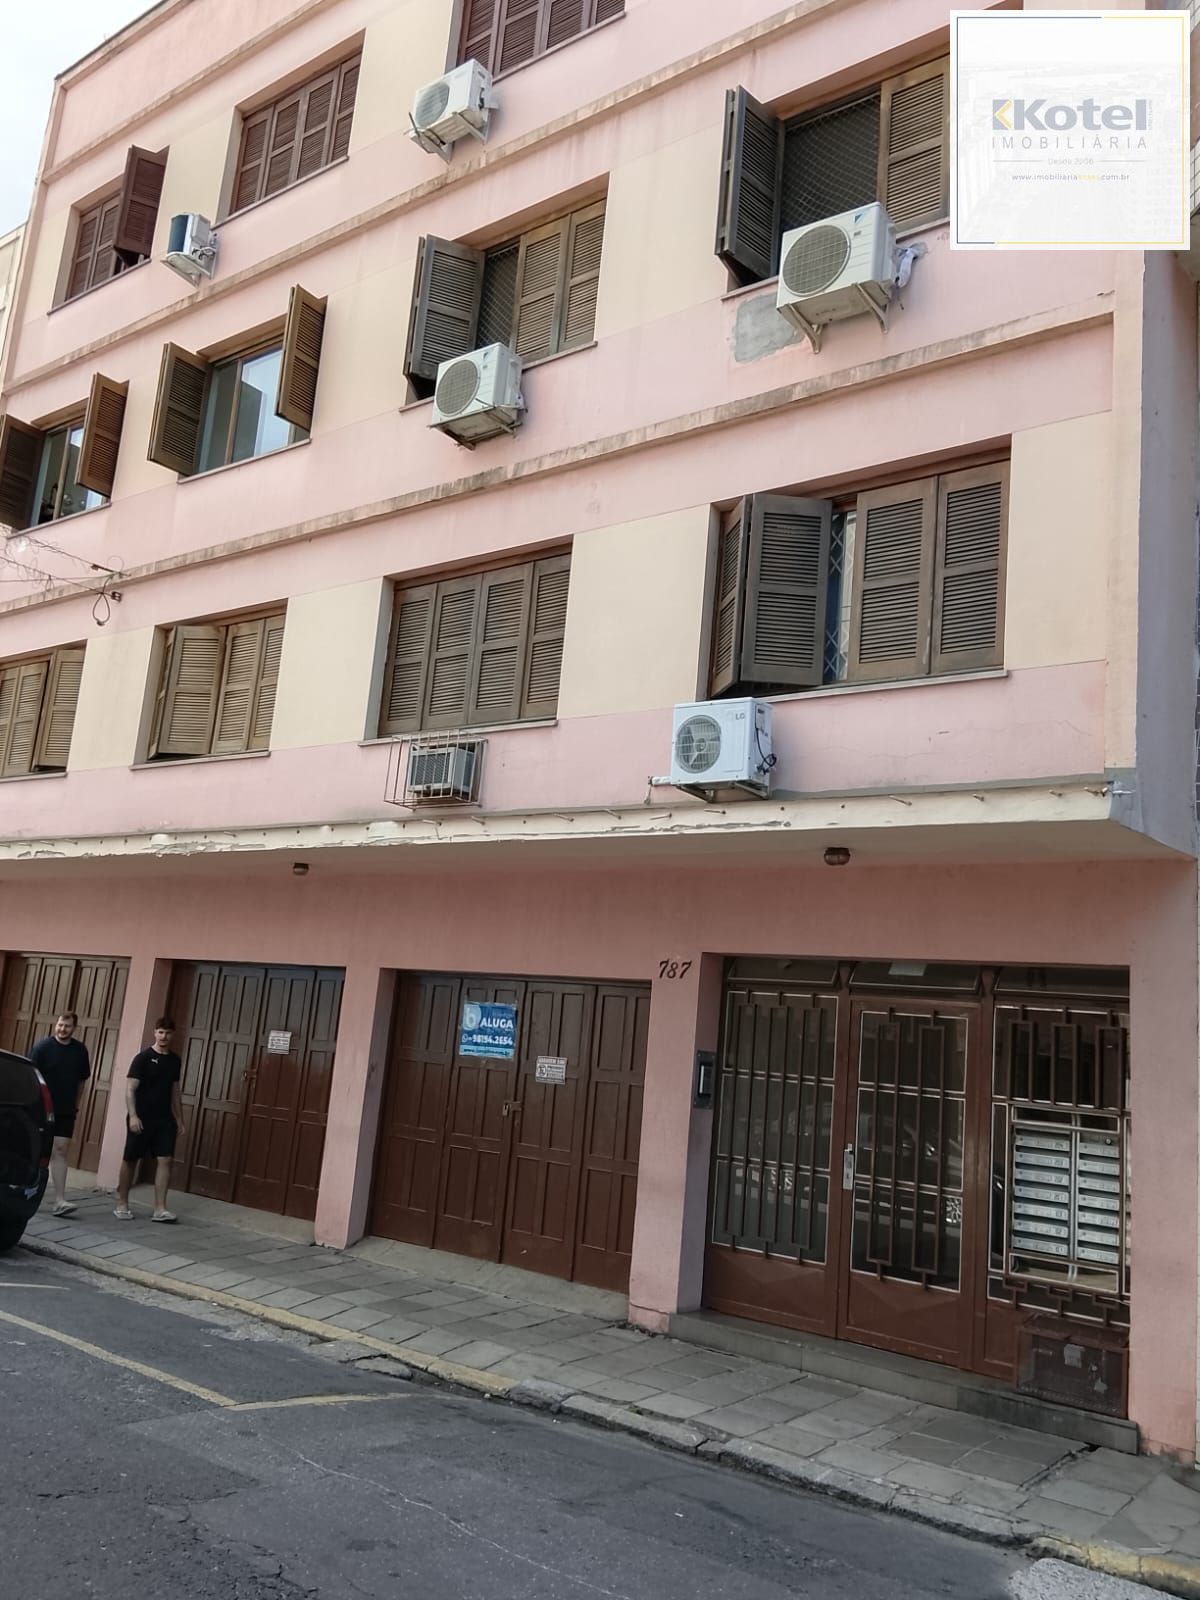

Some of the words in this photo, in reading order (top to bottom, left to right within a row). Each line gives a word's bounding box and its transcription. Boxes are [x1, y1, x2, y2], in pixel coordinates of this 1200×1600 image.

[735, 713, 745, 721] LG
[658, 958, 692, 979] 787
[480, 1017, 514, 1029] ALUGA
